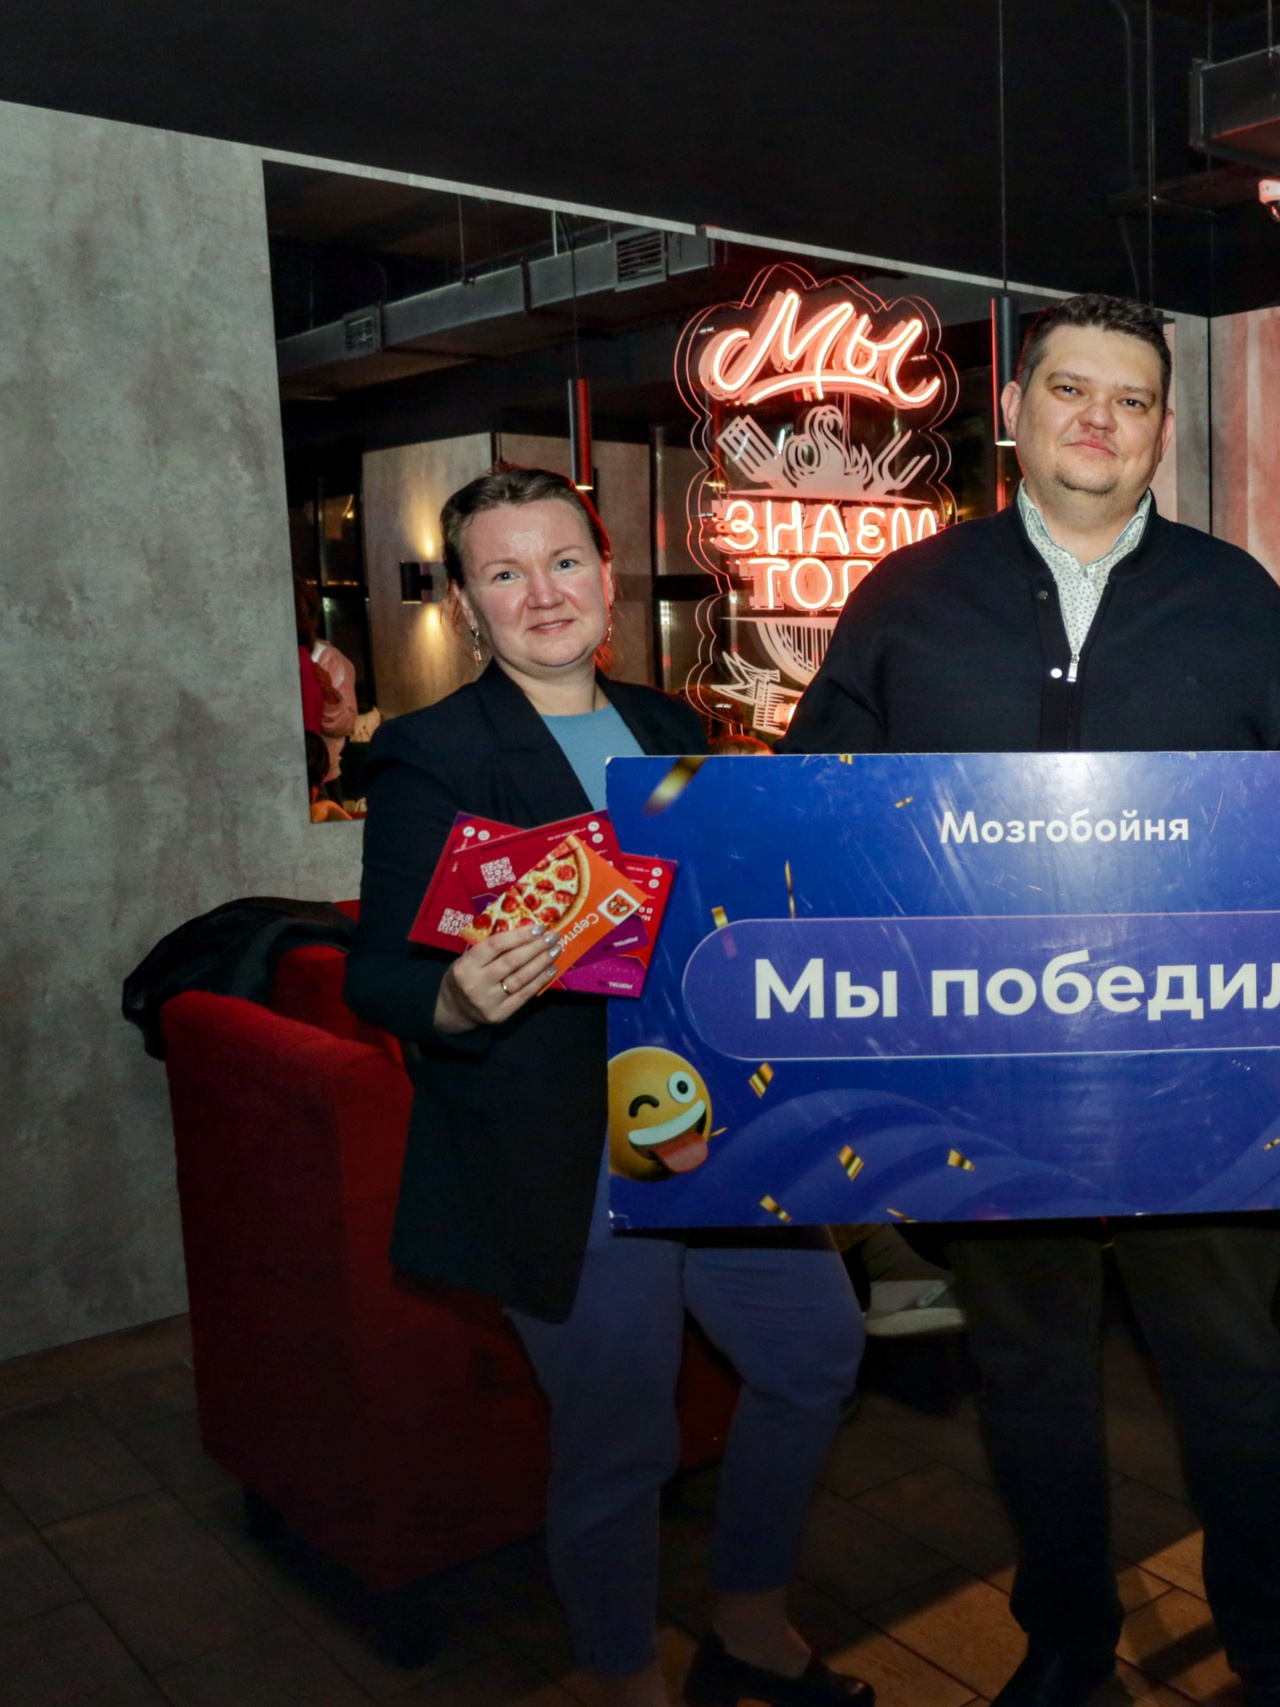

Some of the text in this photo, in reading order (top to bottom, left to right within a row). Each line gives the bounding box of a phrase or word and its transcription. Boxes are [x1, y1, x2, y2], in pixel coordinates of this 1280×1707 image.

[712, 290, 941, 405] Мы
[939, 808, 1191, 845] Мозгобойня
[754, 957, 898, 1020] Мы
